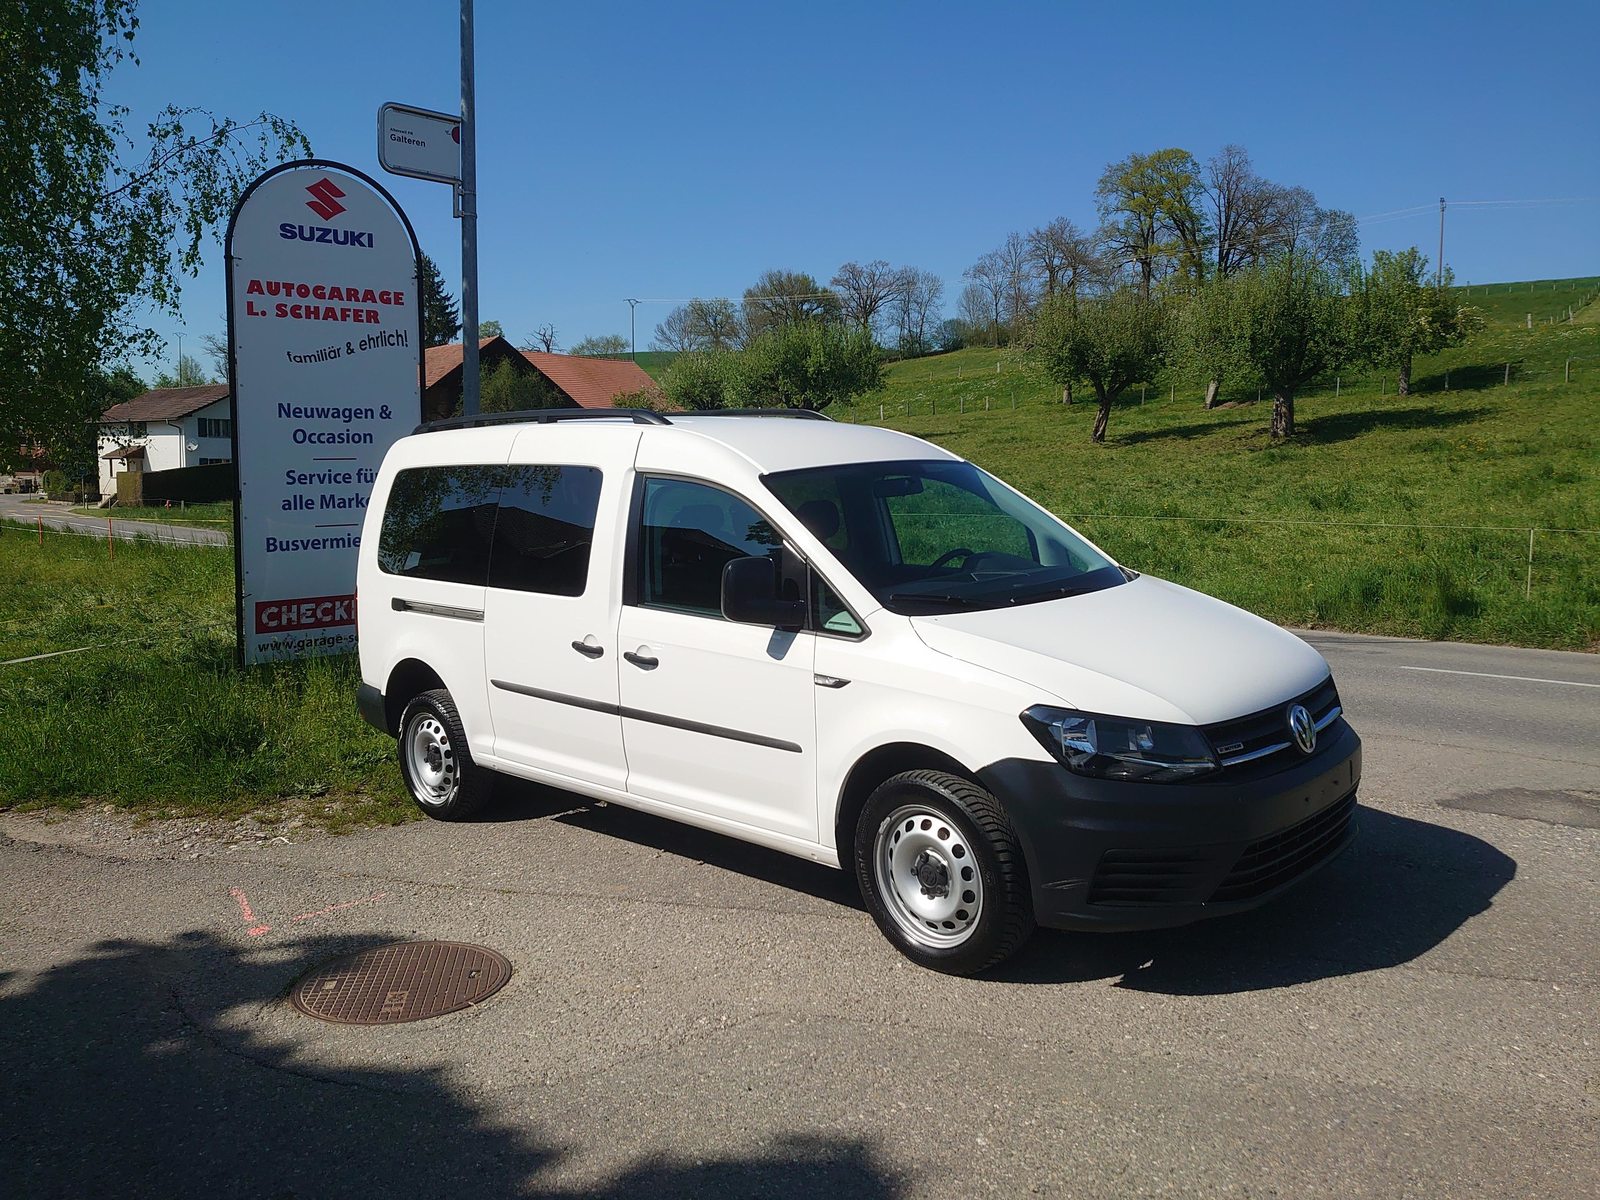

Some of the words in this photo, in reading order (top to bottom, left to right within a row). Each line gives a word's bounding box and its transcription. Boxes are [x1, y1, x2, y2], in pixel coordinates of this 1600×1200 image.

[390, 134, 426, 147] Galteren
[279, 223, 374, 248] SUZUKI
[246, 279, 405, 306] AUTOGARAGE
[246, 301, 267, 317] L.
[275, 303, 380, 324] SCHAFER
[286, 345, 342, 363] familiär
[345, 341, 356, 356] &
[359, 329, 409, 351] ehrlich!
[277, 402, 375, 423] Neuwagen
[379, 404, 393, 420] &
[292, 428, 374, 445] Occasion
[285, 468, 352, 485] Service
[281, 493, 315, 511] alle
[266, 532, 361, 553] Busvermie
[261, 599, 355, 628] CHECK
